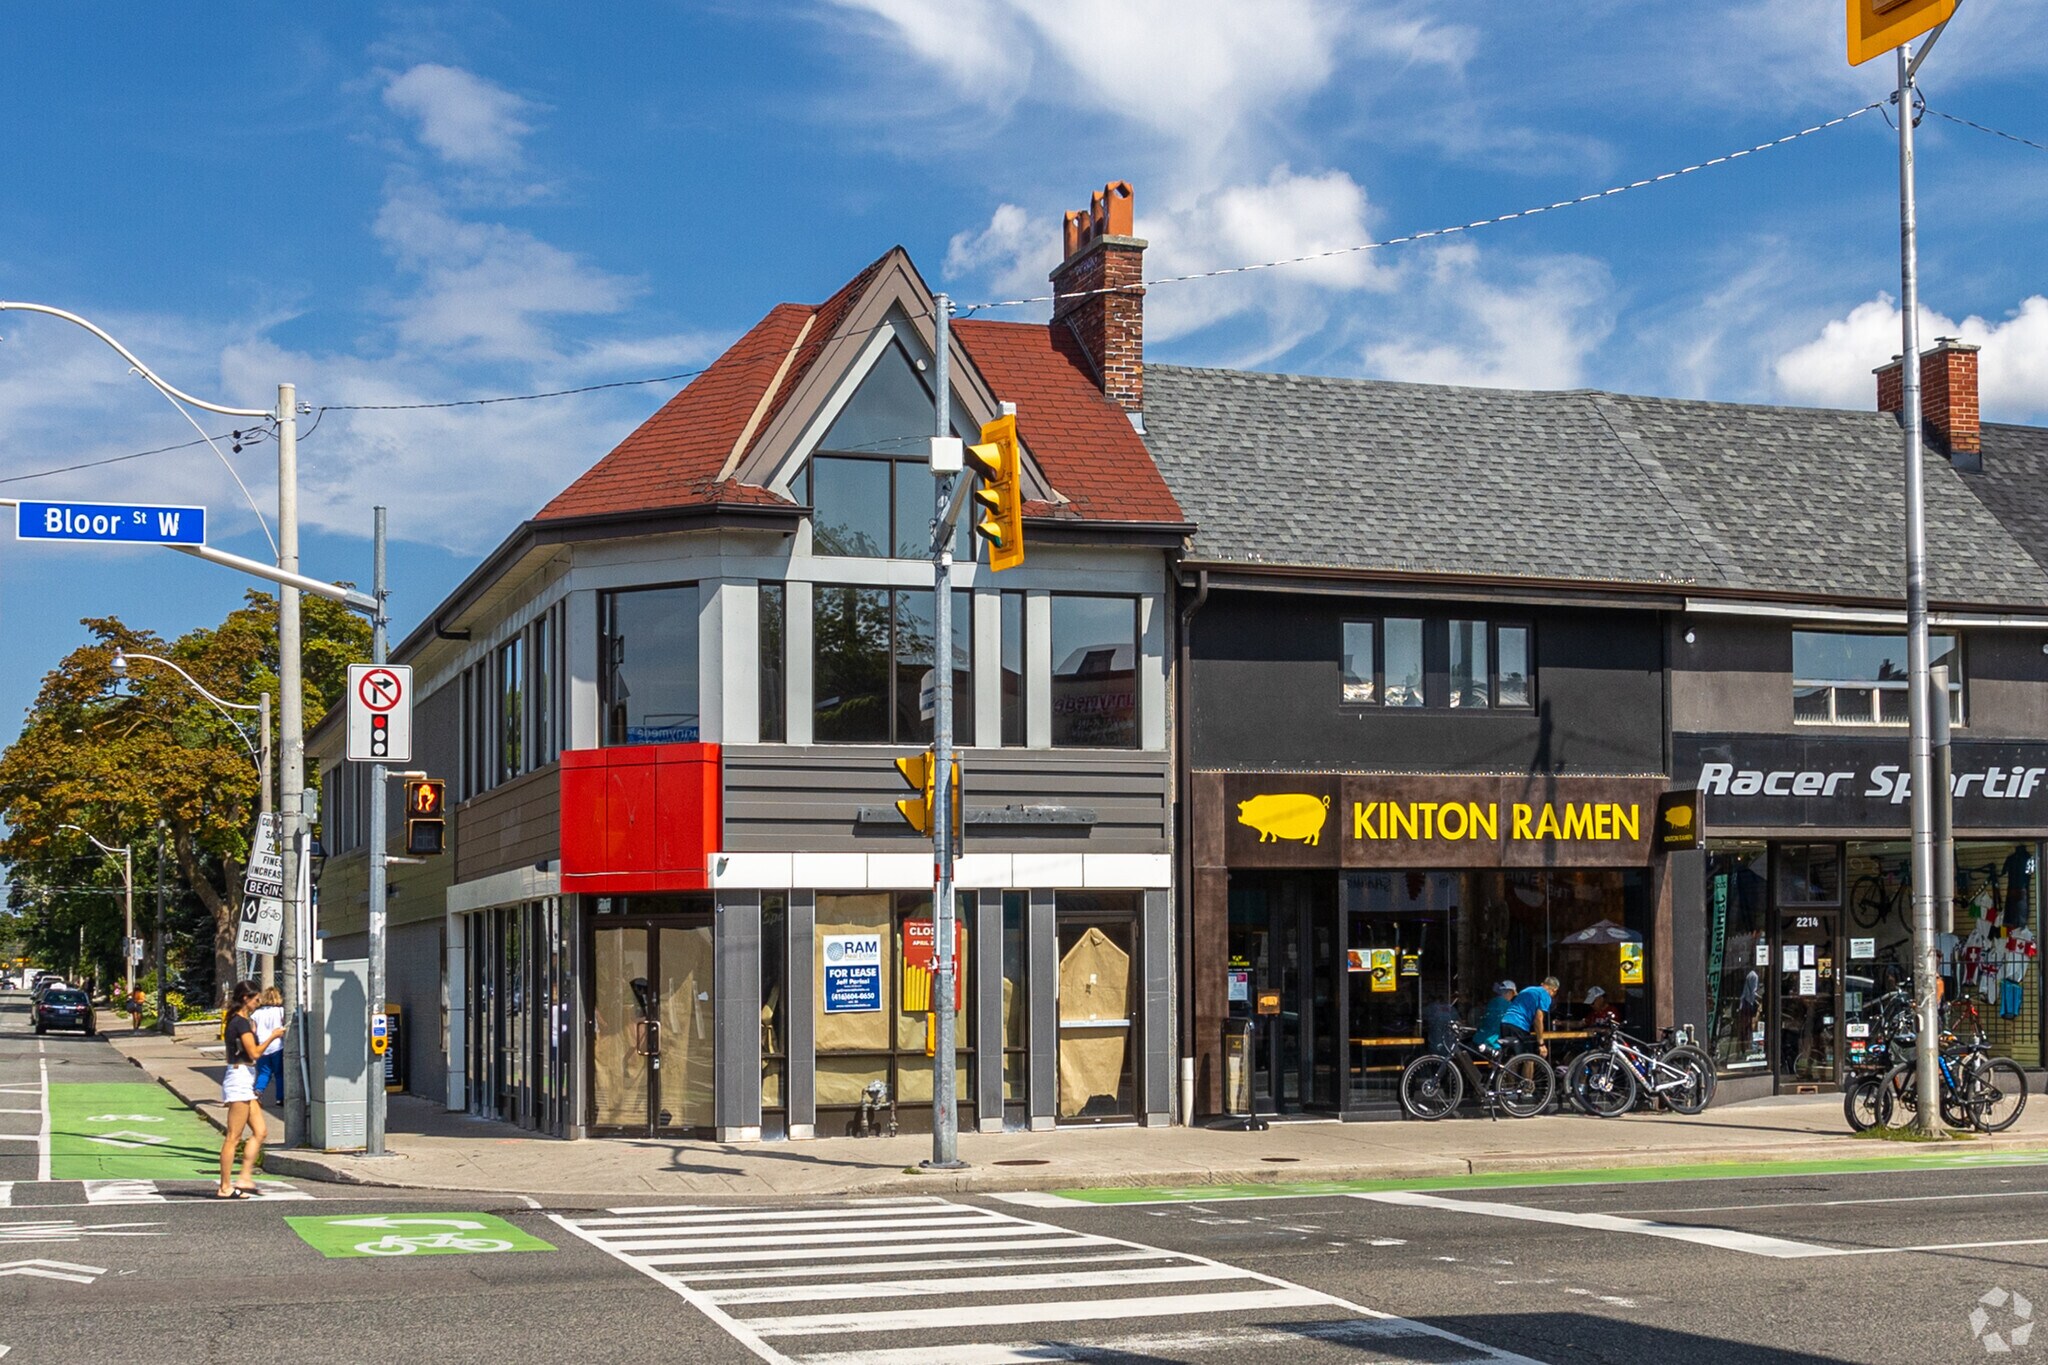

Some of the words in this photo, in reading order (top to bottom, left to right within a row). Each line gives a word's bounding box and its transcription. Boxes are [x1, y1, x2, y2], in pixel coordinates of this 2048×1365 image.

[46, 507, 121, 535] Bloor
[133, 511, 147, 525] St
[158, 511, 180, 537] W
[1699, 762, 1855, 796] Racer
[1864, 765, 2047, 805] Sprtif
[1354, 801, 1498, 840] KINTON
[1512, 802, 1639, 840] RAMEN
[250, 866, 282, 879] INCREAS
[249, 881, 283, 897] BEGINS
[1796, 916, 1819, 928] 2214
[243, 929, 274, 947] BEGINS
[844, 941, 877, 954] RAM
[829, 969, 848, 978] FOR
[850, 968, 877, 977] LEASE
